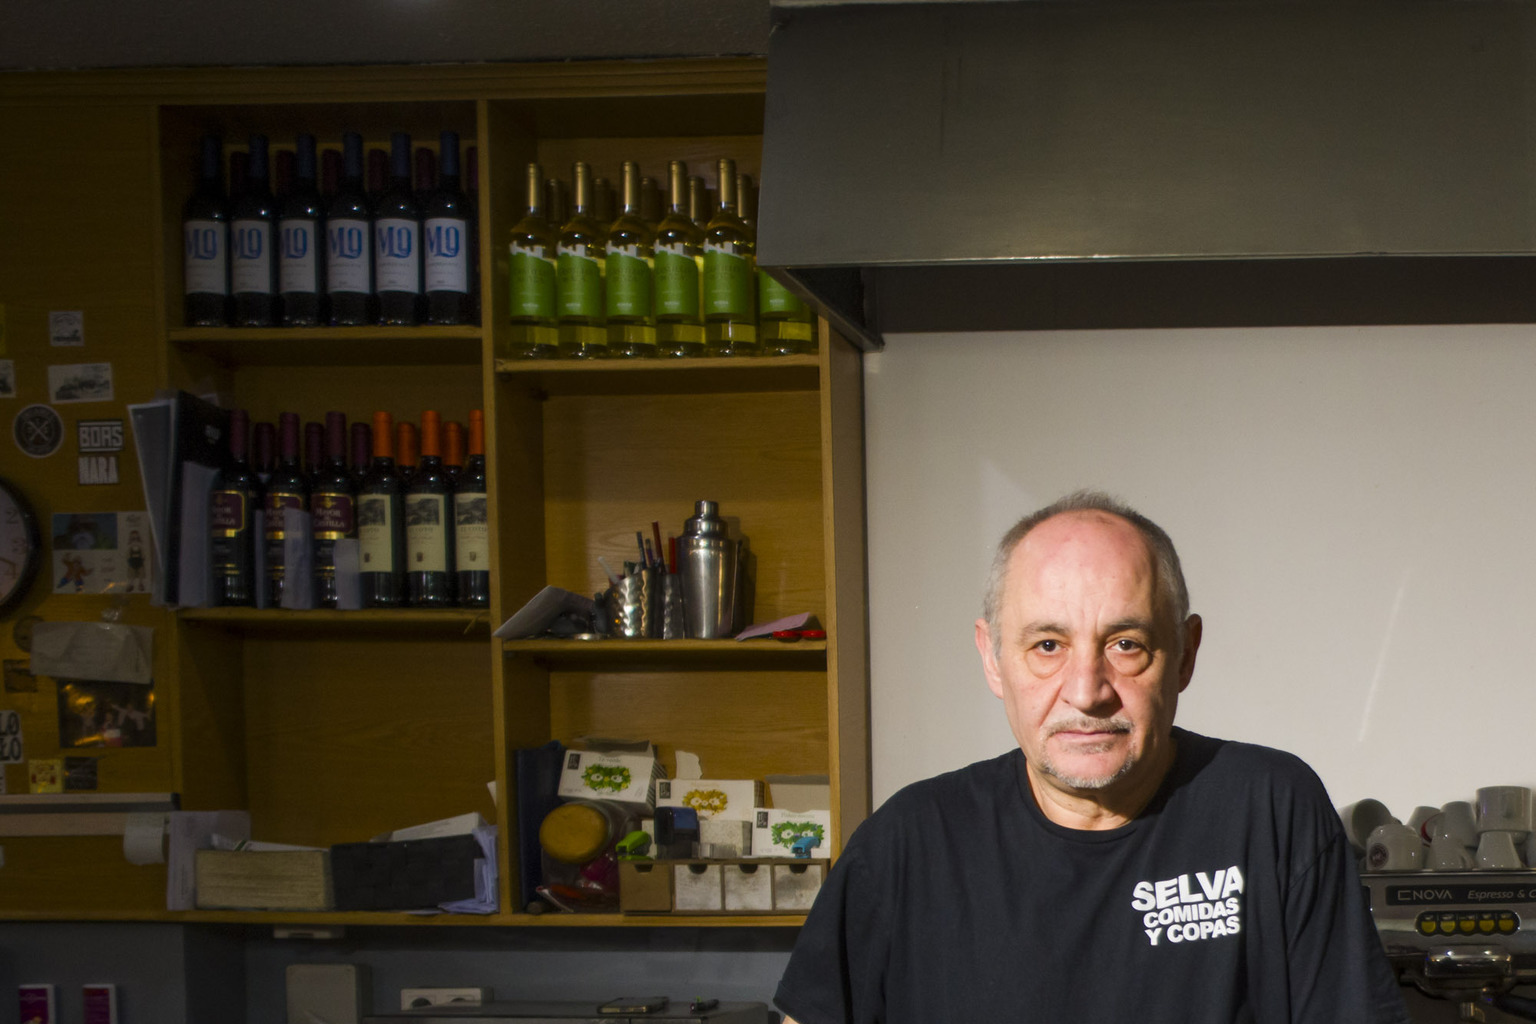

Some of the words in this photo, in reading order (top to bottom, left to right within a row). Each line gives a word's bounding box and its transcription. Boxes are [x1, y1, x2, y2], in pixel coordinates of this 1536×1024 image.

[1130, 865, 1244, 911] SELVA
[1467, 890, 1514, 901] Espresso
[1516, 889, 1526, 898] &
[1142, 897, 1241, 928] COMIDAS
[1144, 927, 1163, 946] Y
[1166, 916, 1241, 943] COPAS
